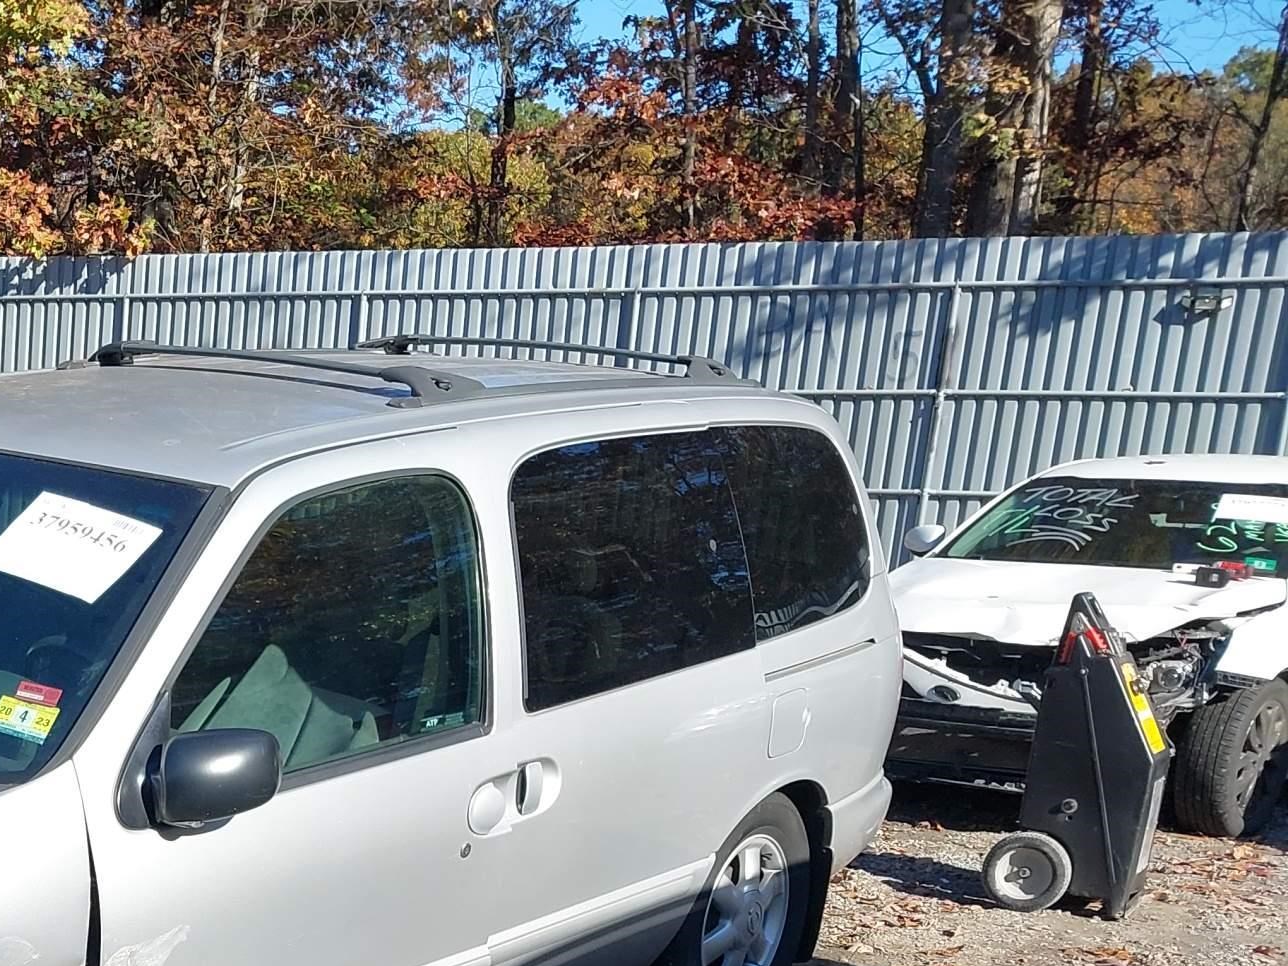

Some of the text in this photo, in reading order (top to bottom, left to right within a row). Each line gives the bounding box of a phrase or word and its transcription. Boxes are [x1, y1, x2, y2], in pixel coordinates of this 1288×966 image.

[1023, 485, 1140, 508] TOTAL
[1033, 503, 1119, 532] LOSS
[29, 511, 129, 553] 37959456
[19, 710, 29, 723] 4
[35, 716, 51, 727] 23
